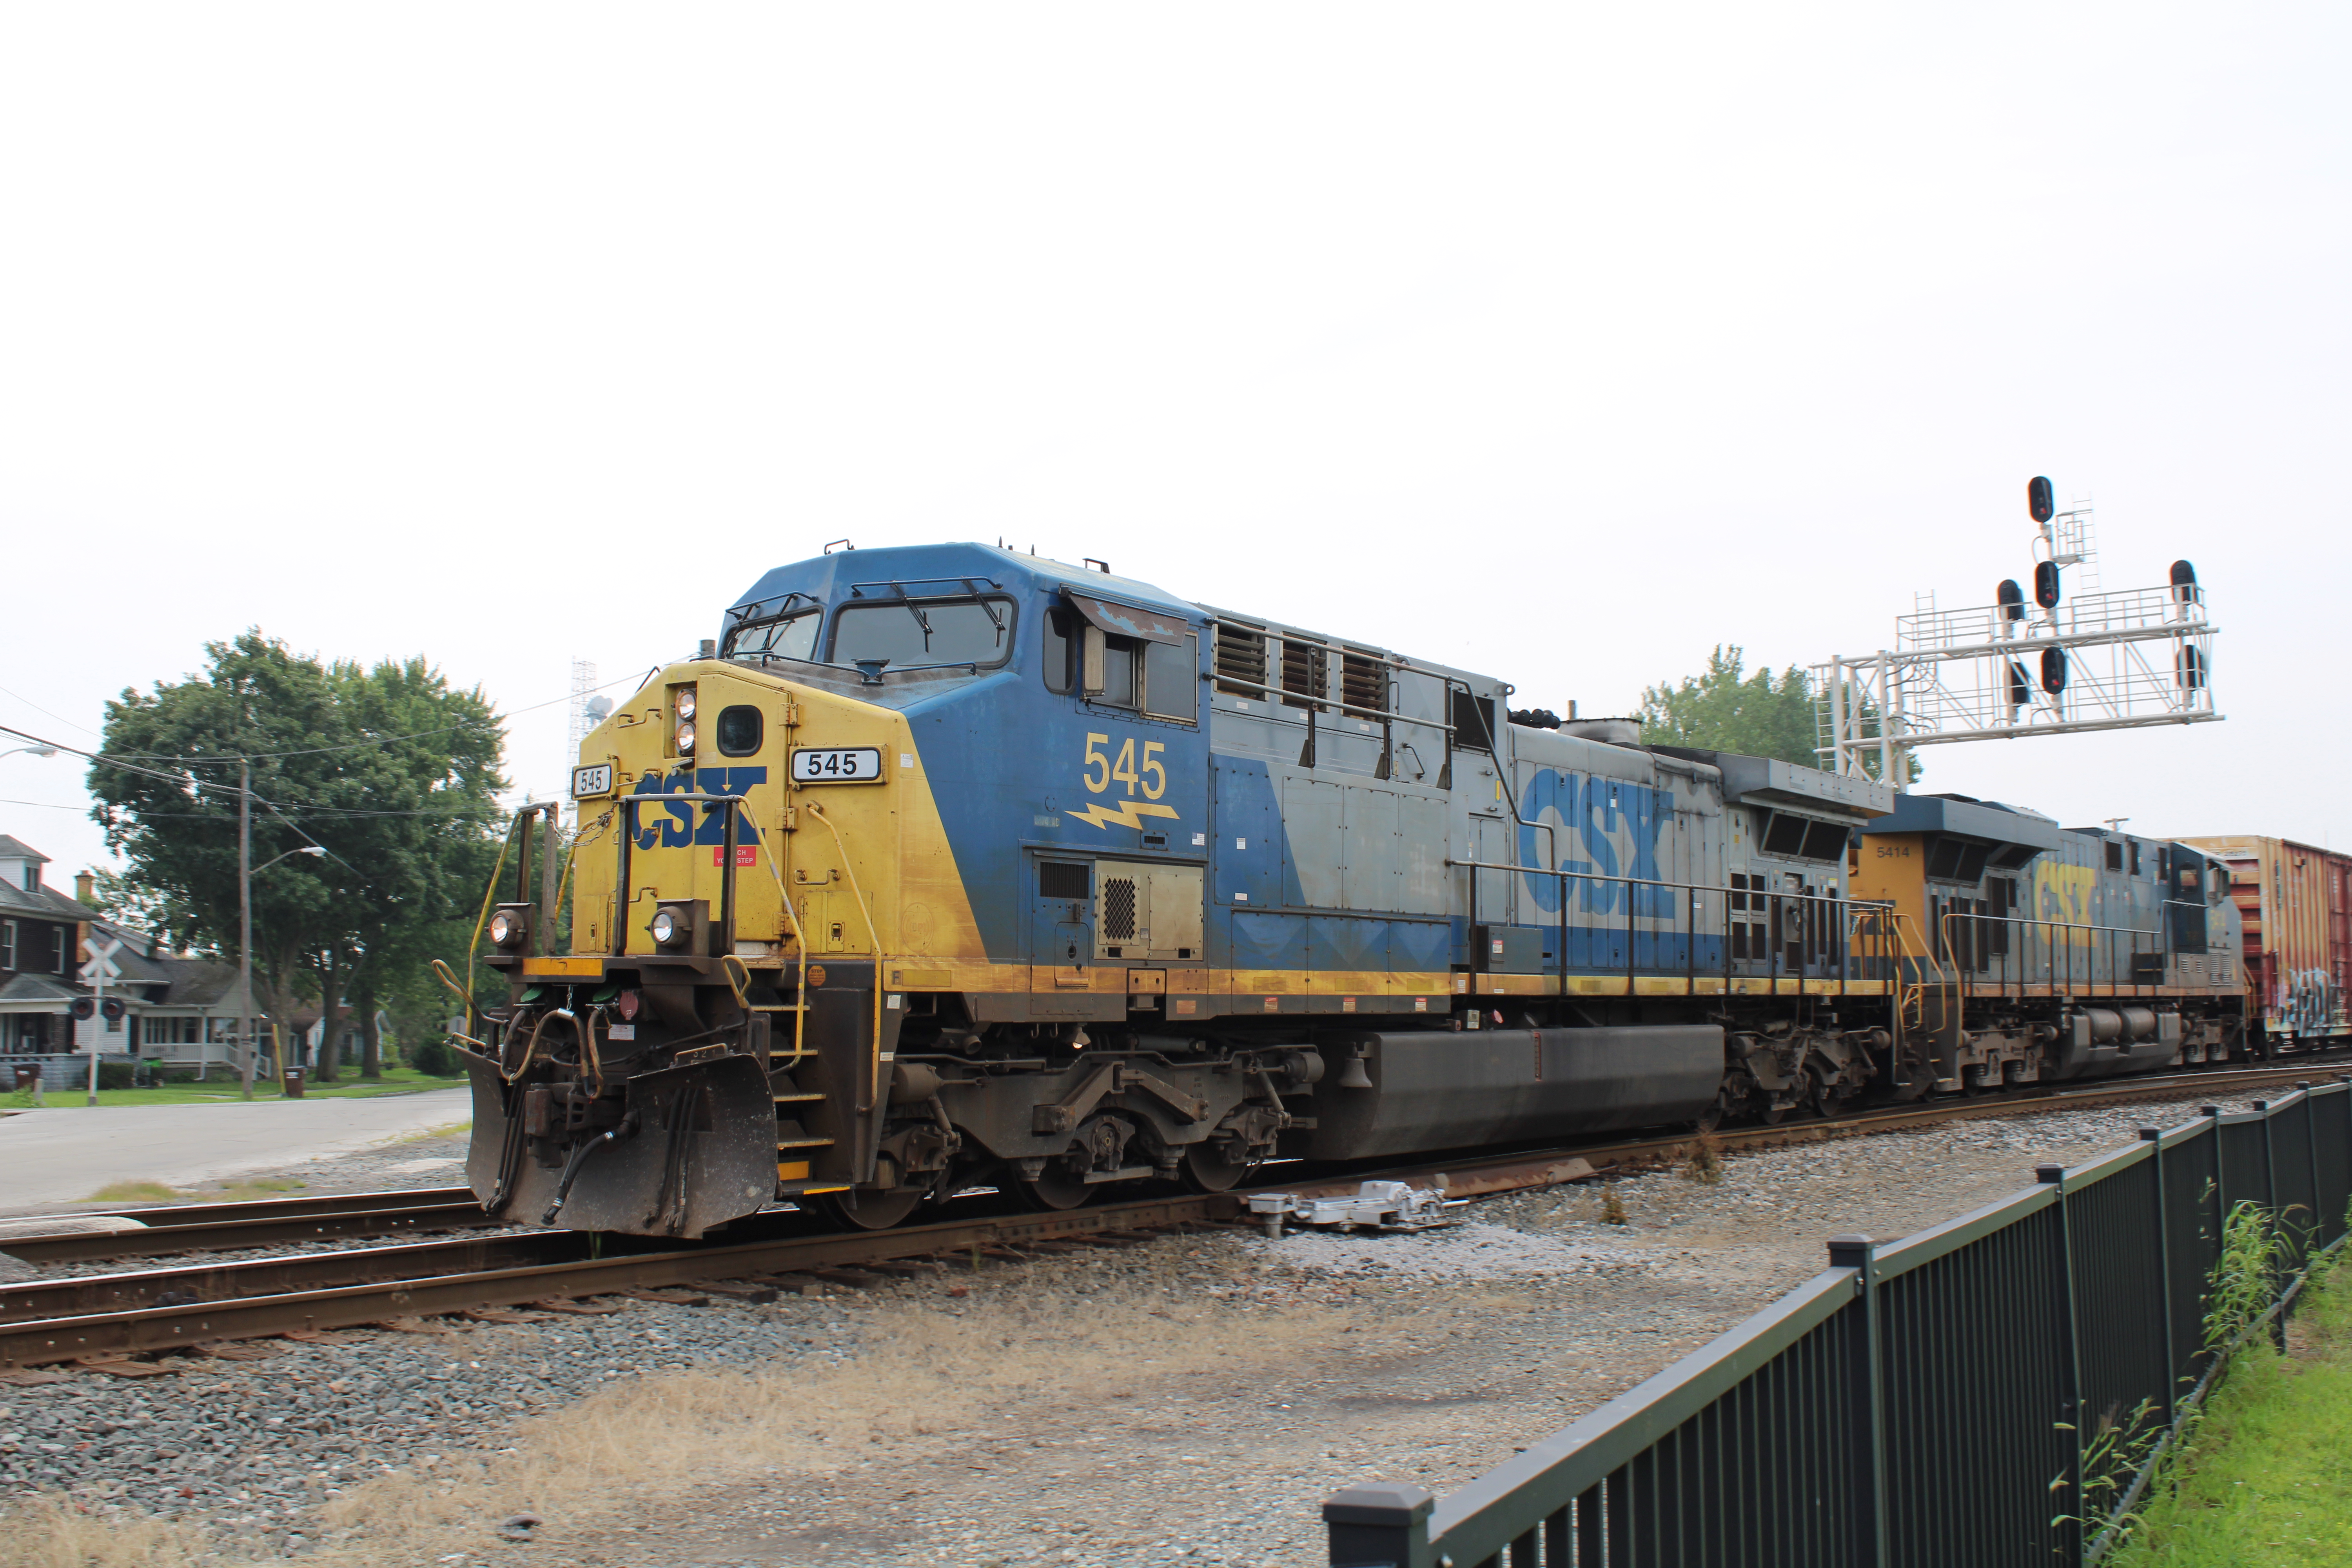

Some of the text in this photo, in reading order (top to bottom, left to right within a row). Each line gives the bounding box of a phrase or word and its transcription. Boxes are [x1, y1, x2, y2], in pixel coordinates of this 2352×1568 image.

[581, 770, 602, 791] 545
[808, 753, 857, 775] 545
[1083, 732, 1166, 800] 545
[632, 766, 767, 850] CSX
[1519, 768, 1675, 920] CSX
[1877, 847, 1910, 858] 5414
[2034, 860, 2098, 947] CSX
